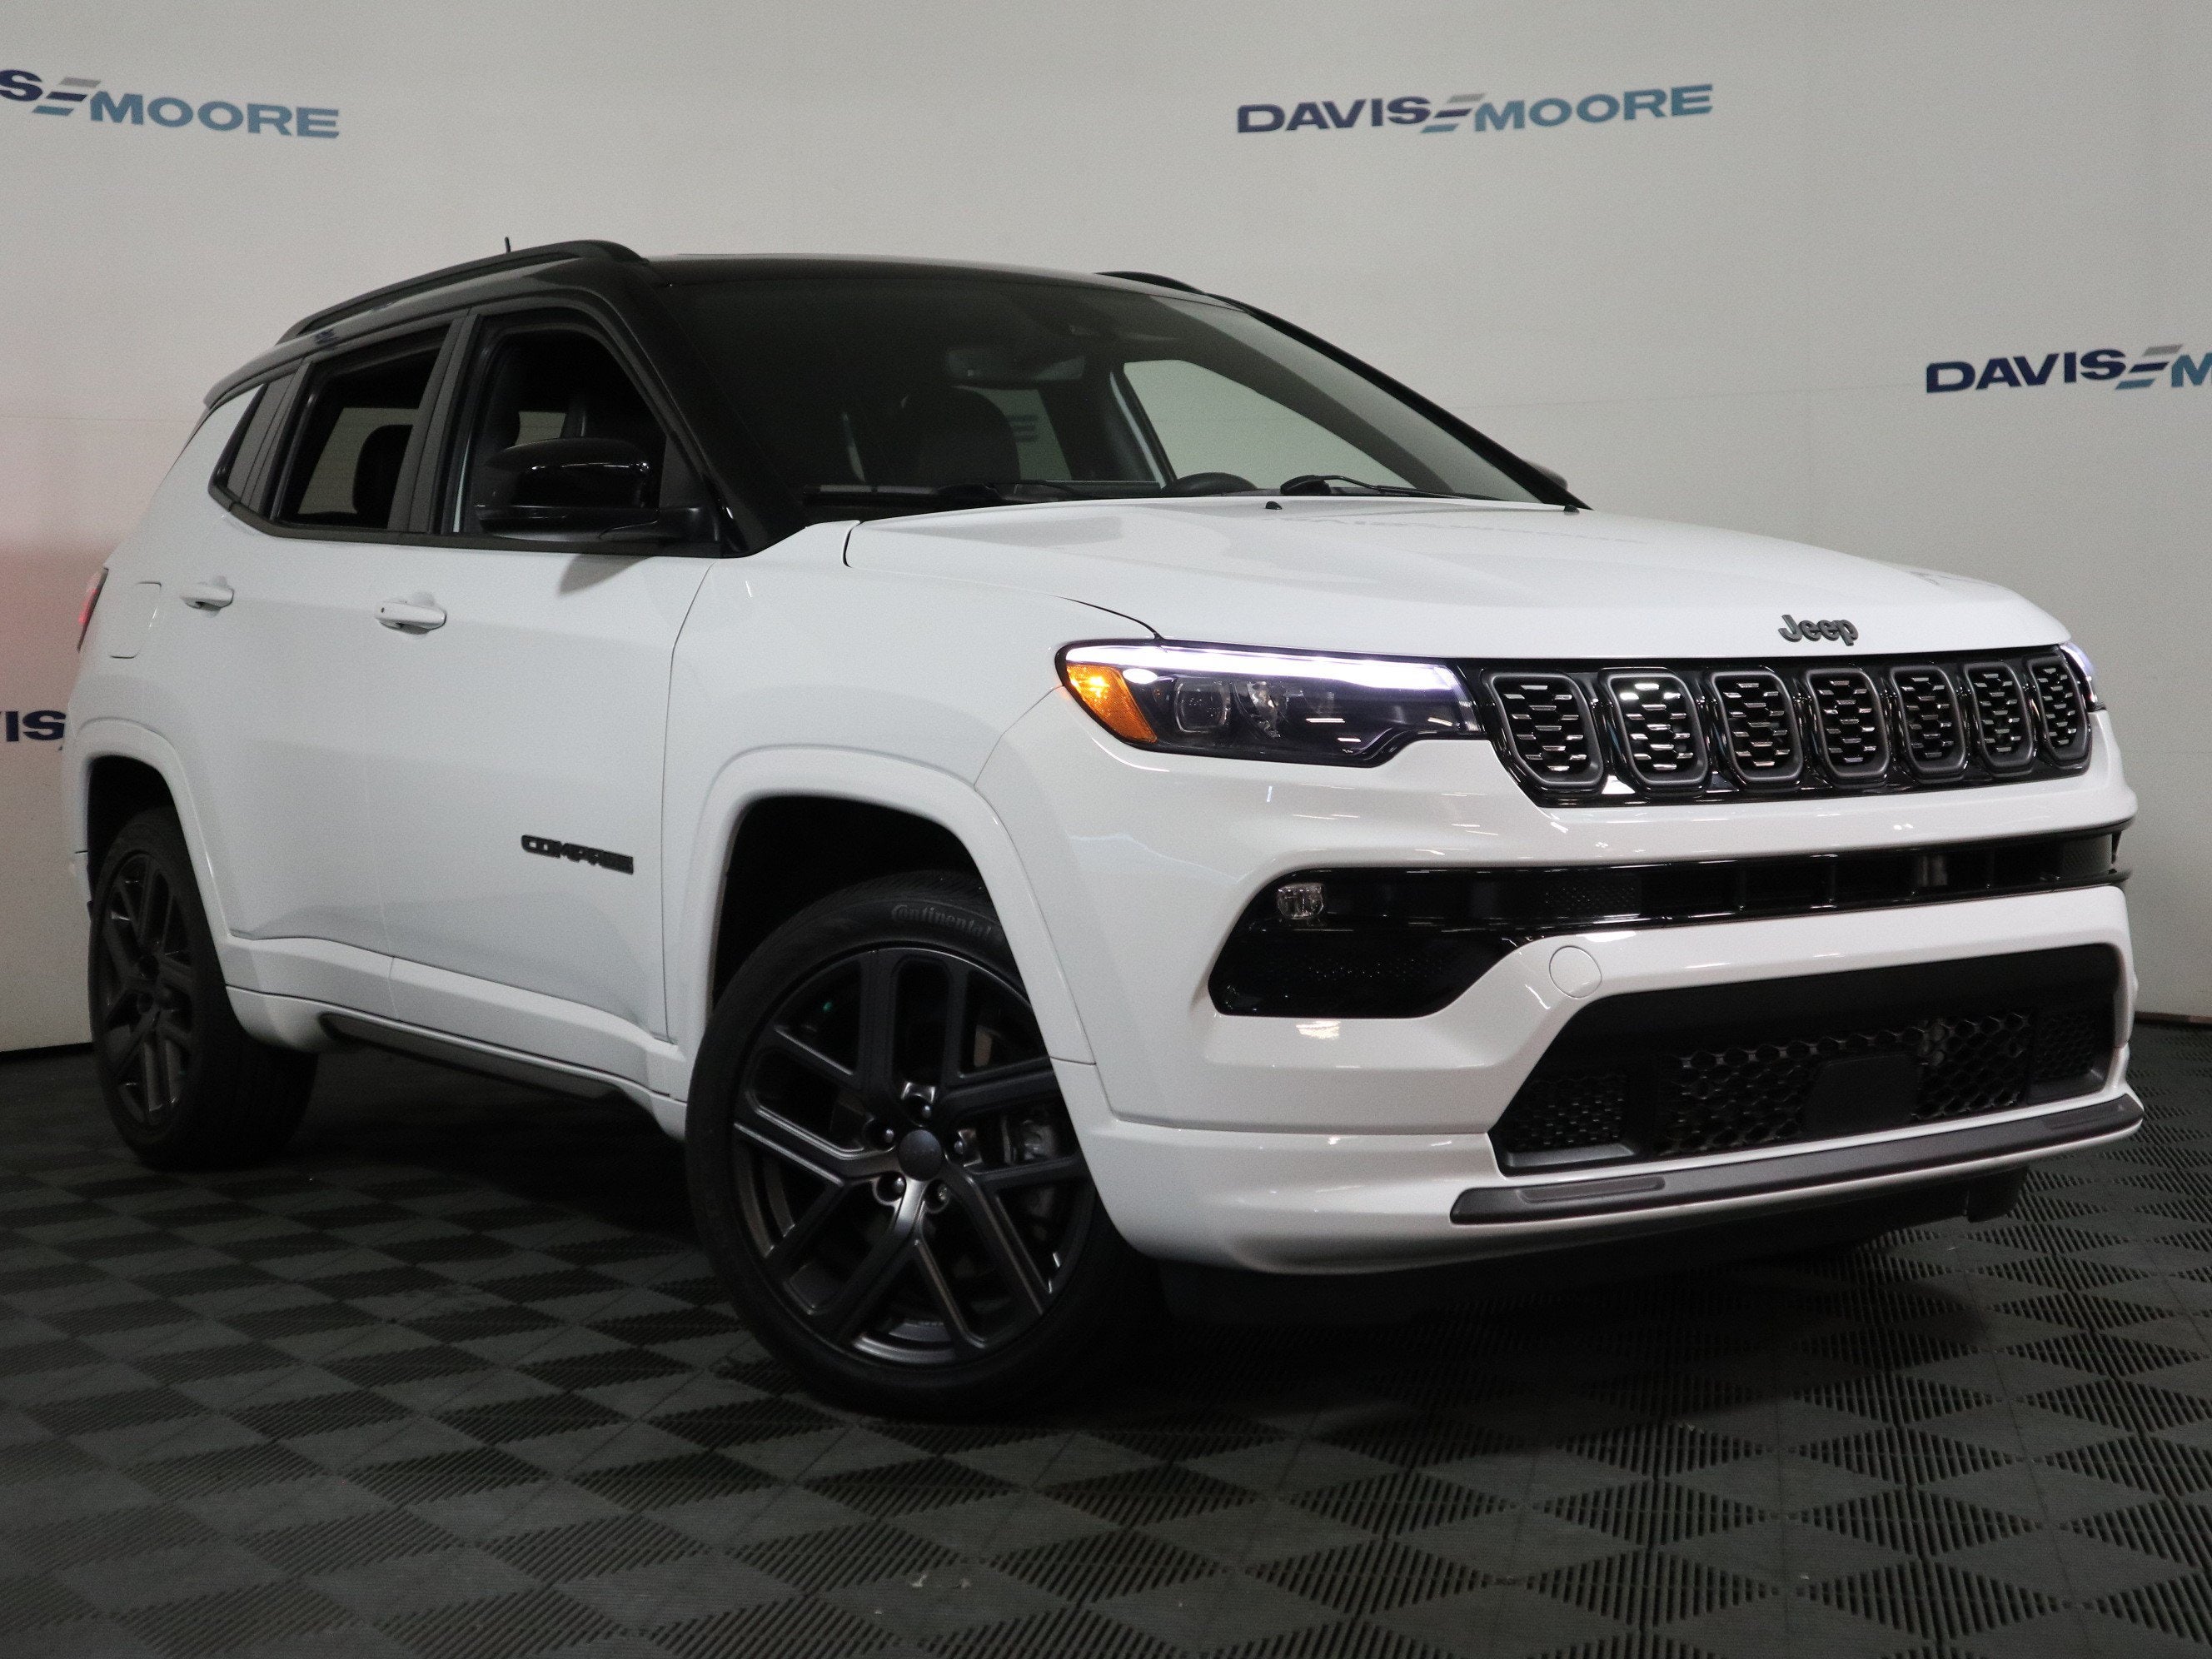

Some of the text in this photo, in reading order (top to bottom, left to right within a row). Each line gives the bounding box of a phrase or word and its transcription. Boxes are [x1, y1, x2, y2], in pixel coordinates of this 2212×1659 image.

[90, 91, 340, 139] MOORE
[1237, 84, 1713, 133] DAVIS MOORE
[1926, 348, 2126, 394] DAVIS
[1778, 614, 1859, 646] Jeep
[521, 834, 634, 875] COMPA
[891, 904, 992, 939] Continental
